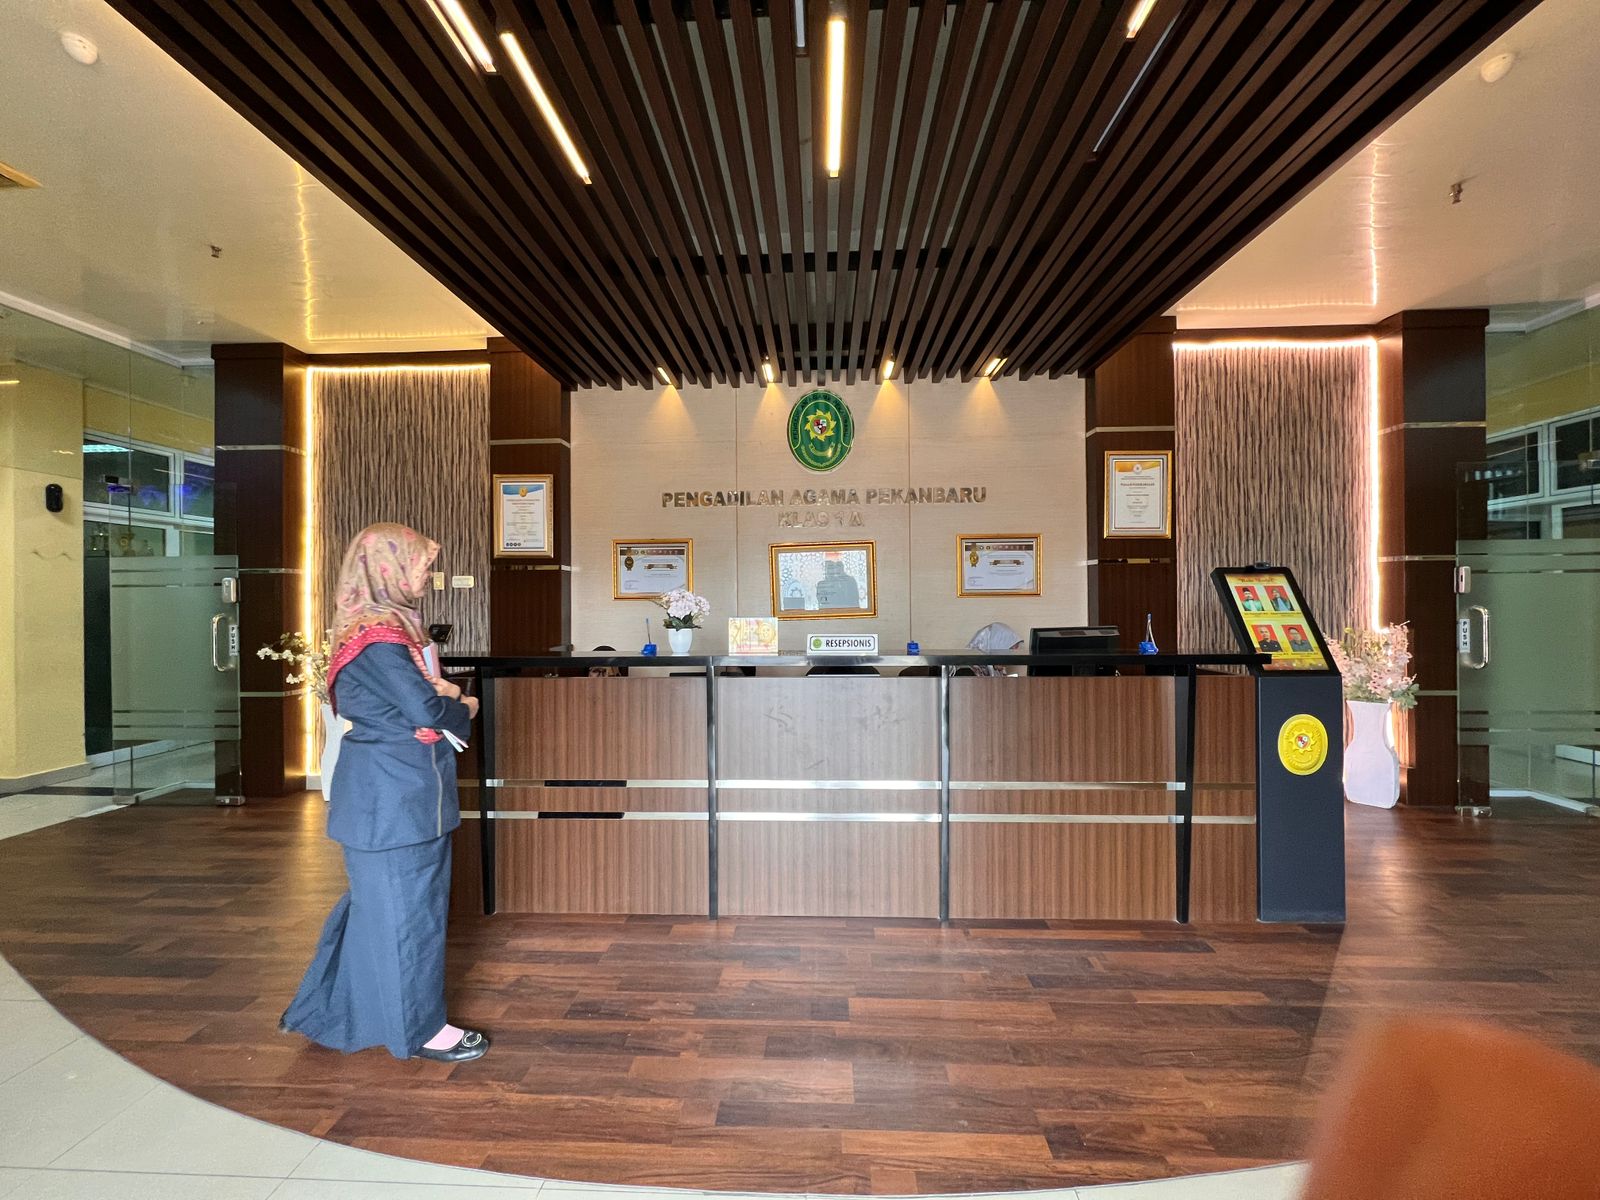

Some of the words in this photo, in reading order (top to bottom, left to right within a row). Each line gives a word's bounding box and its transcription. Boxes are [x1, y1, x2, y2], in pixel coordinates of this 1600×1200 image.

[662, 489, 785, 508] PENGADILAN
[789, 488, 861, 506] AGAMA
[865, 486, 988, 504] PEKANBARU
[778, 511, 830, 528] KLAS
[825, 639, 872, 648] RESEPSIONIS
